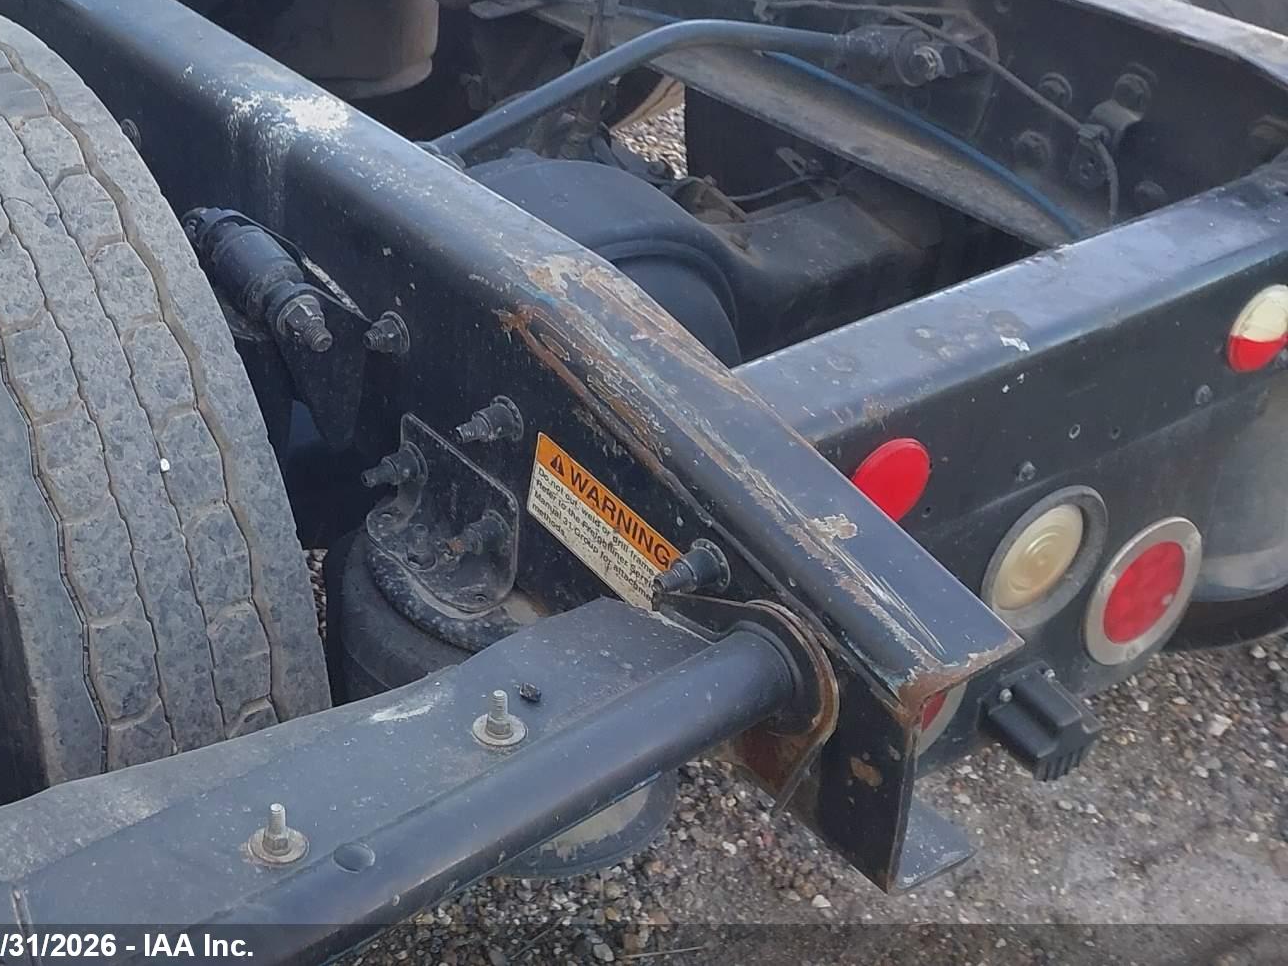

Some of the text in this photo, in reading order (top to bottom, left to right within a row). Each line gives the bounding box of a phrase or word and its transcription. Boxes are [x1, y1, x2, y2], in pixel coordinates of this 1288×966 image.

[532, 503, 567, 539] methods.
[534, 490, 562, 519] Manual
[574, 528, 599, 553] Group
[600, 551, 612, 566] for
[613, 565, 652, 602] attachme
[536, 480, 652, 588] Refer to the Freightliner Servi
[539, 468, 549, 481] Do
[550, 480, 564, 494] not
[581, 508, 602, 527] weld
[602, 526, 611, 537] or
[612, 536, 629, 553] drill
[570, 465, 671, 569] WARNING
